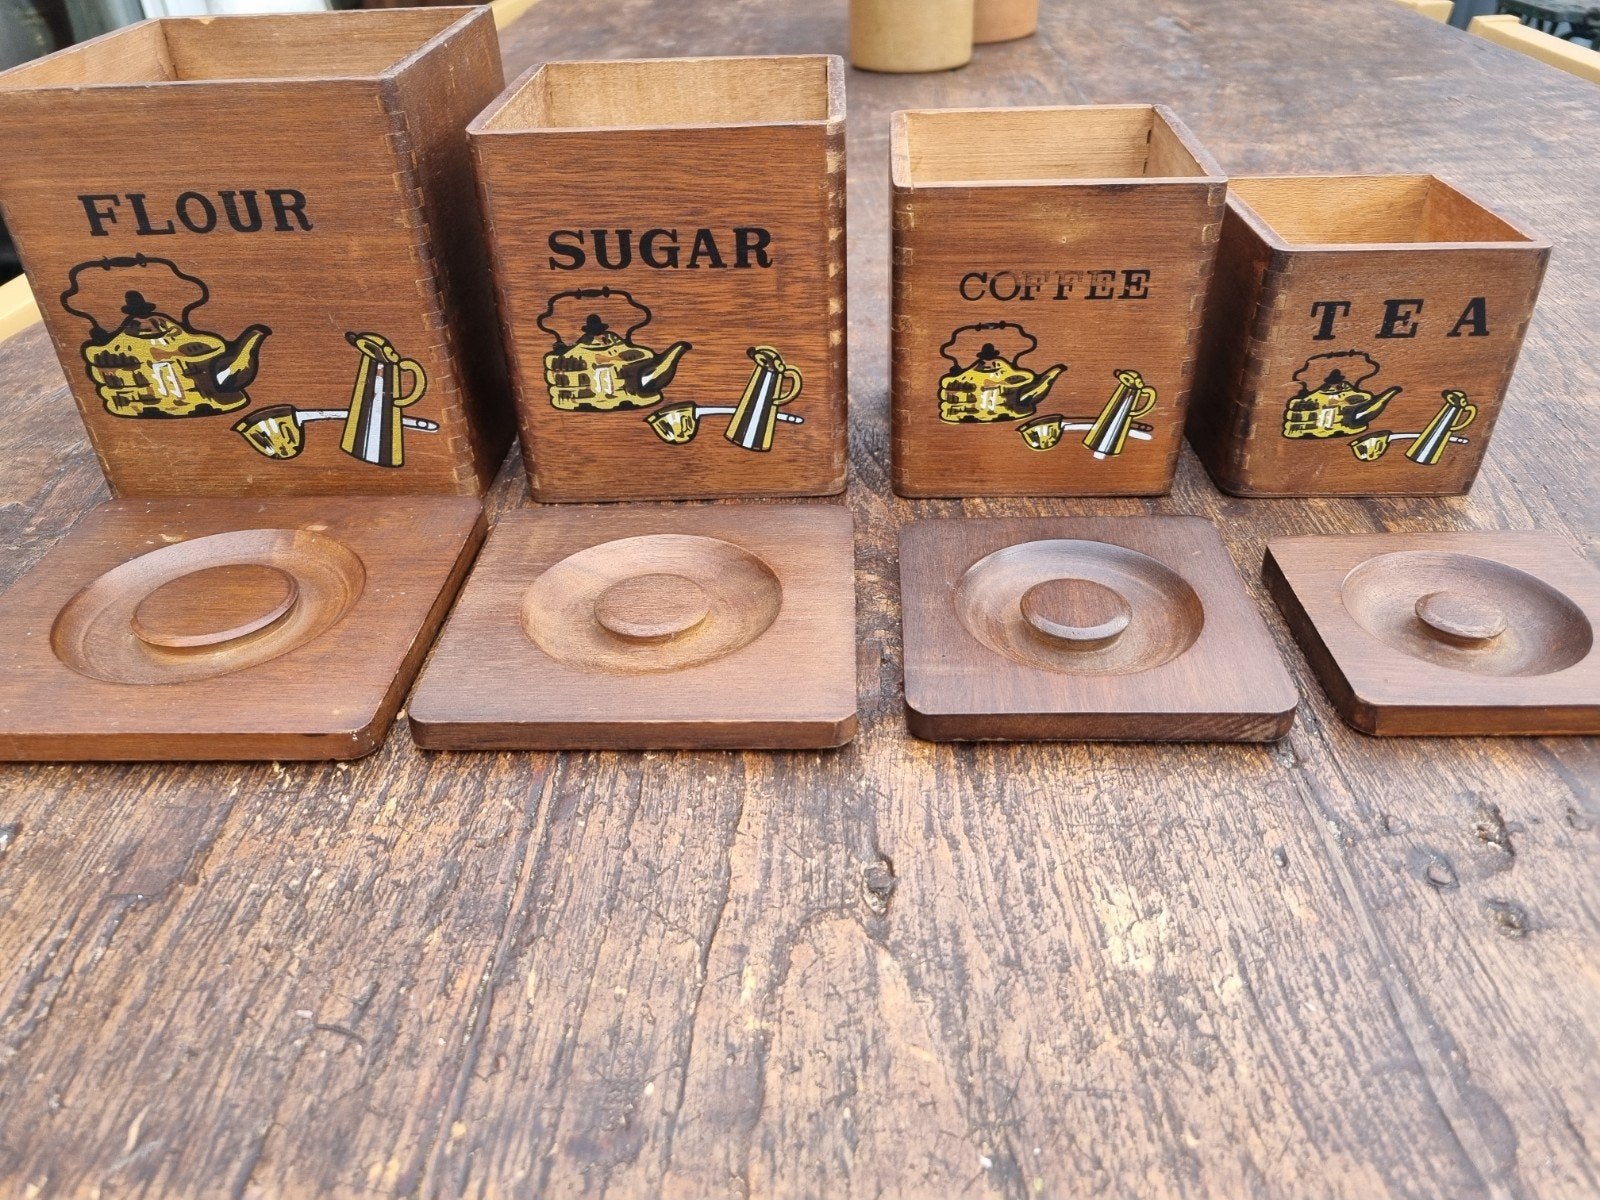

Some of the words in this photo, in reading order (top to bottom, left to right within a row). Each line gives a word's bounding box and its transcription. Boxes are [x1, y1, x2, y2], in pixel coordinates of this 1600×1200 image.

[78, 188, 313, 236] FLOUR
[547, 227, 774, 270] SUGAR
[959, 269, 1151, 301] COFFEE
[1310, 297, 1490, 340] TEA
